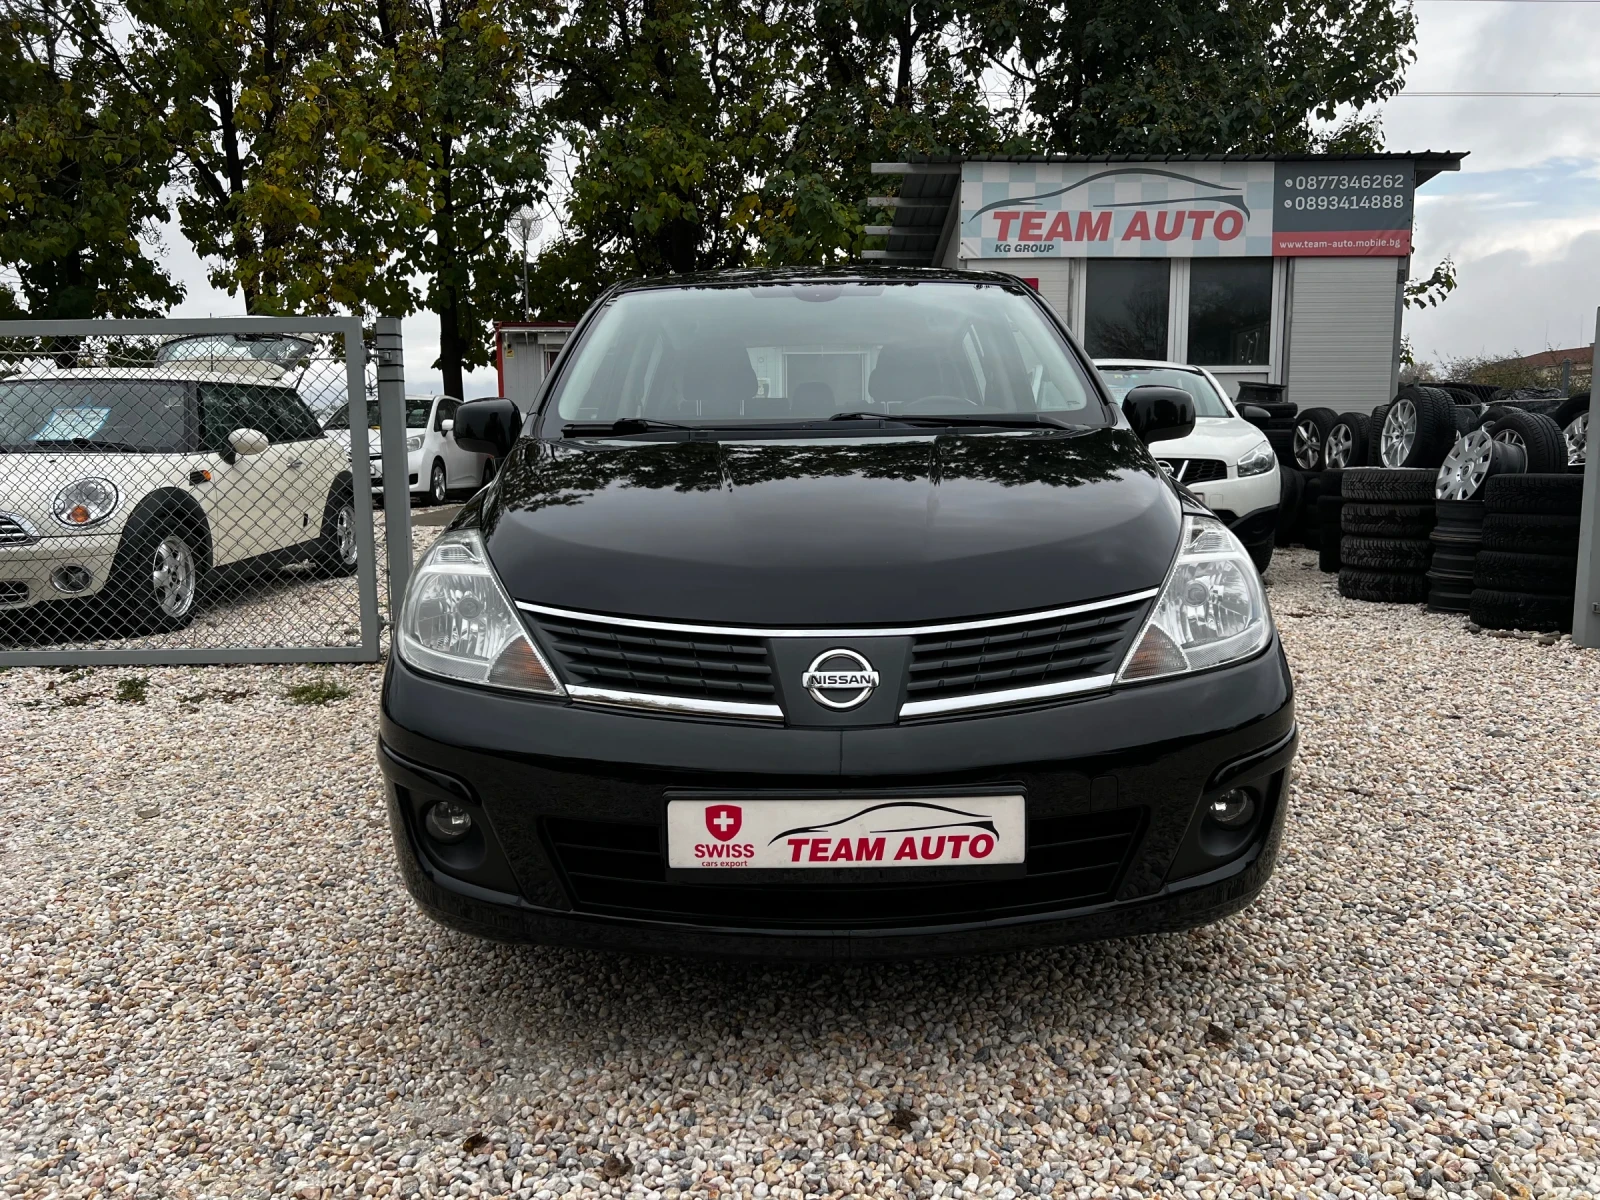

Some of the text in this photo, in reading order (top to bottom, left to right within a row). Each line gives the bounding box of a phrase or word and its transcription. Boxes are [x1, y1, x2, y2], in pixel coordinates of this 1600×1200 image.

[1295, 174, 1404, 190] 0877346262
[1295, 195, 1404, 210] 0893414888
[993, 210, 1244, 242] TEAM AUTO
[994, 244, 1055, 253] KG GROUP
[1279, 238, 1401, 249] www.team-auto.mobile.bg
[811, 675, 871, 685] NISSAN
[694, 843, 755, 859] SWISS
[786, 834, 995, 863] TEAM AUTO
[720, 860, 748, 868] export
